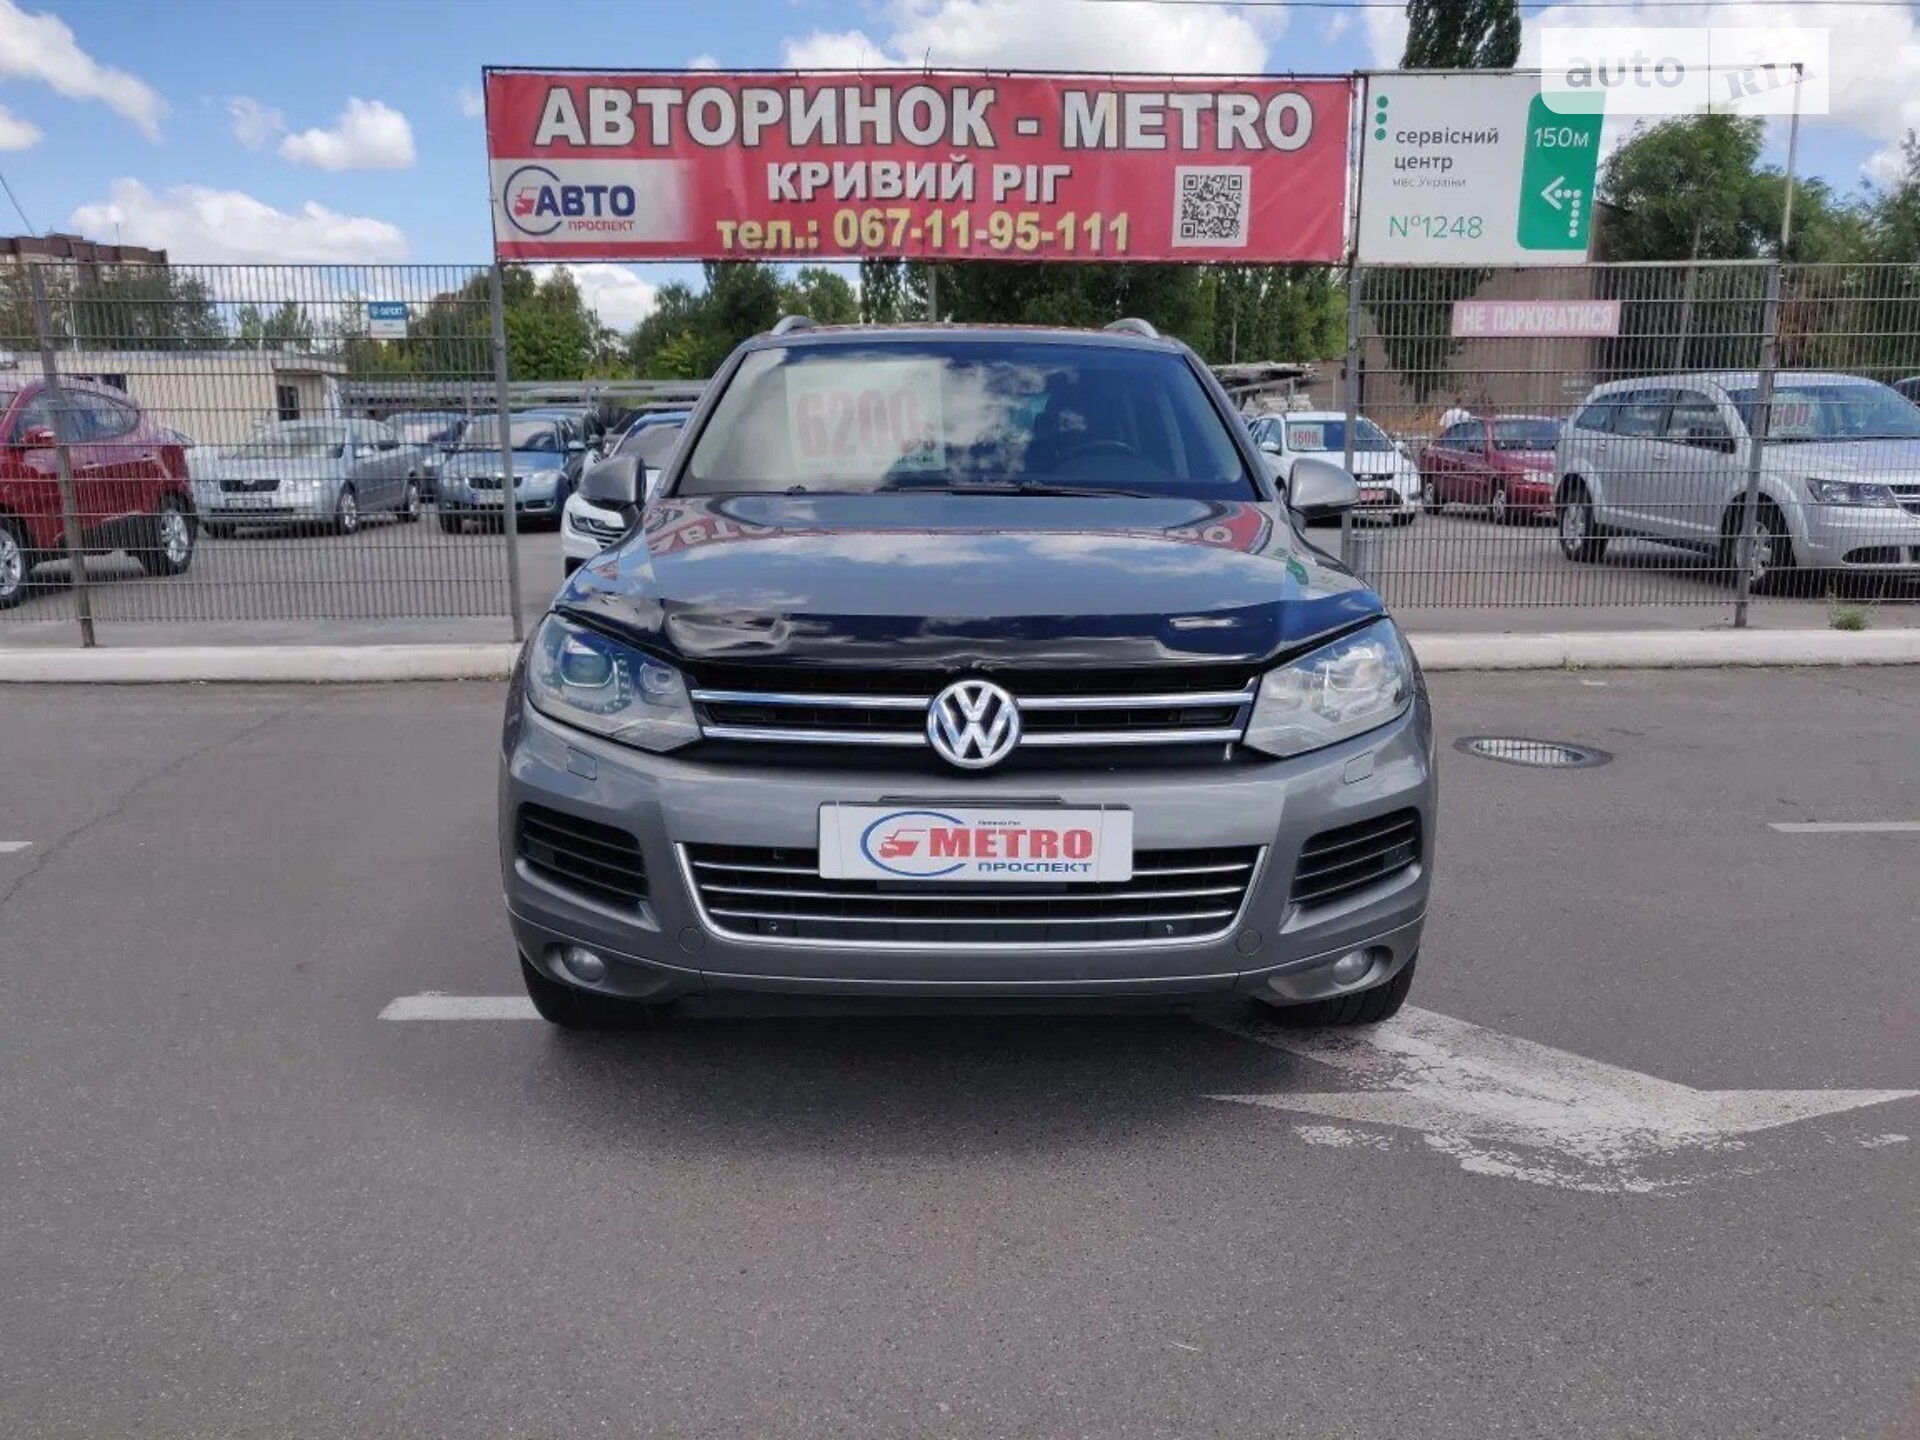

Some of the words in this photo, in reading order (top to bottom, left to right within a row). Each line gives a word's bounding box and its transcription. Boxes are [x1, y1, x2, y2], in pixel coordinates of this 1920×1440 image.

[534, 86, 996, 148] АВТОРИНОК
[1062, 90, 1314, 152] METRO
[1396, 126, 1499, 148] сервісний
[1534, 127, 1589, 148] 150м
[766, 153, 976, 203] КРИВИЙ
[993, 163, 1072, 204] РІГ
[1394, 155, 1453, 173] центр
[1418, 175, 1466, 190] України
[534, 185, 636, 217] АВТО
[569, 220, 635, 232] ПРОСПЕКТ
[716, 219, 818, 250] тел.:
[833, 208, 1129, 253] 067-11-95-111
[1462, 305, 1486, 332] НЕ
[1493, 305, 1614, 332] ПАРКУВАТИСЯ
[797, 386, 924, 458] 6200
[929, 681, 1017, 766] VW
[929, 827, 1094, 861] METRO
[977, 862, 1093, 873] ПРОСПЕКТ
